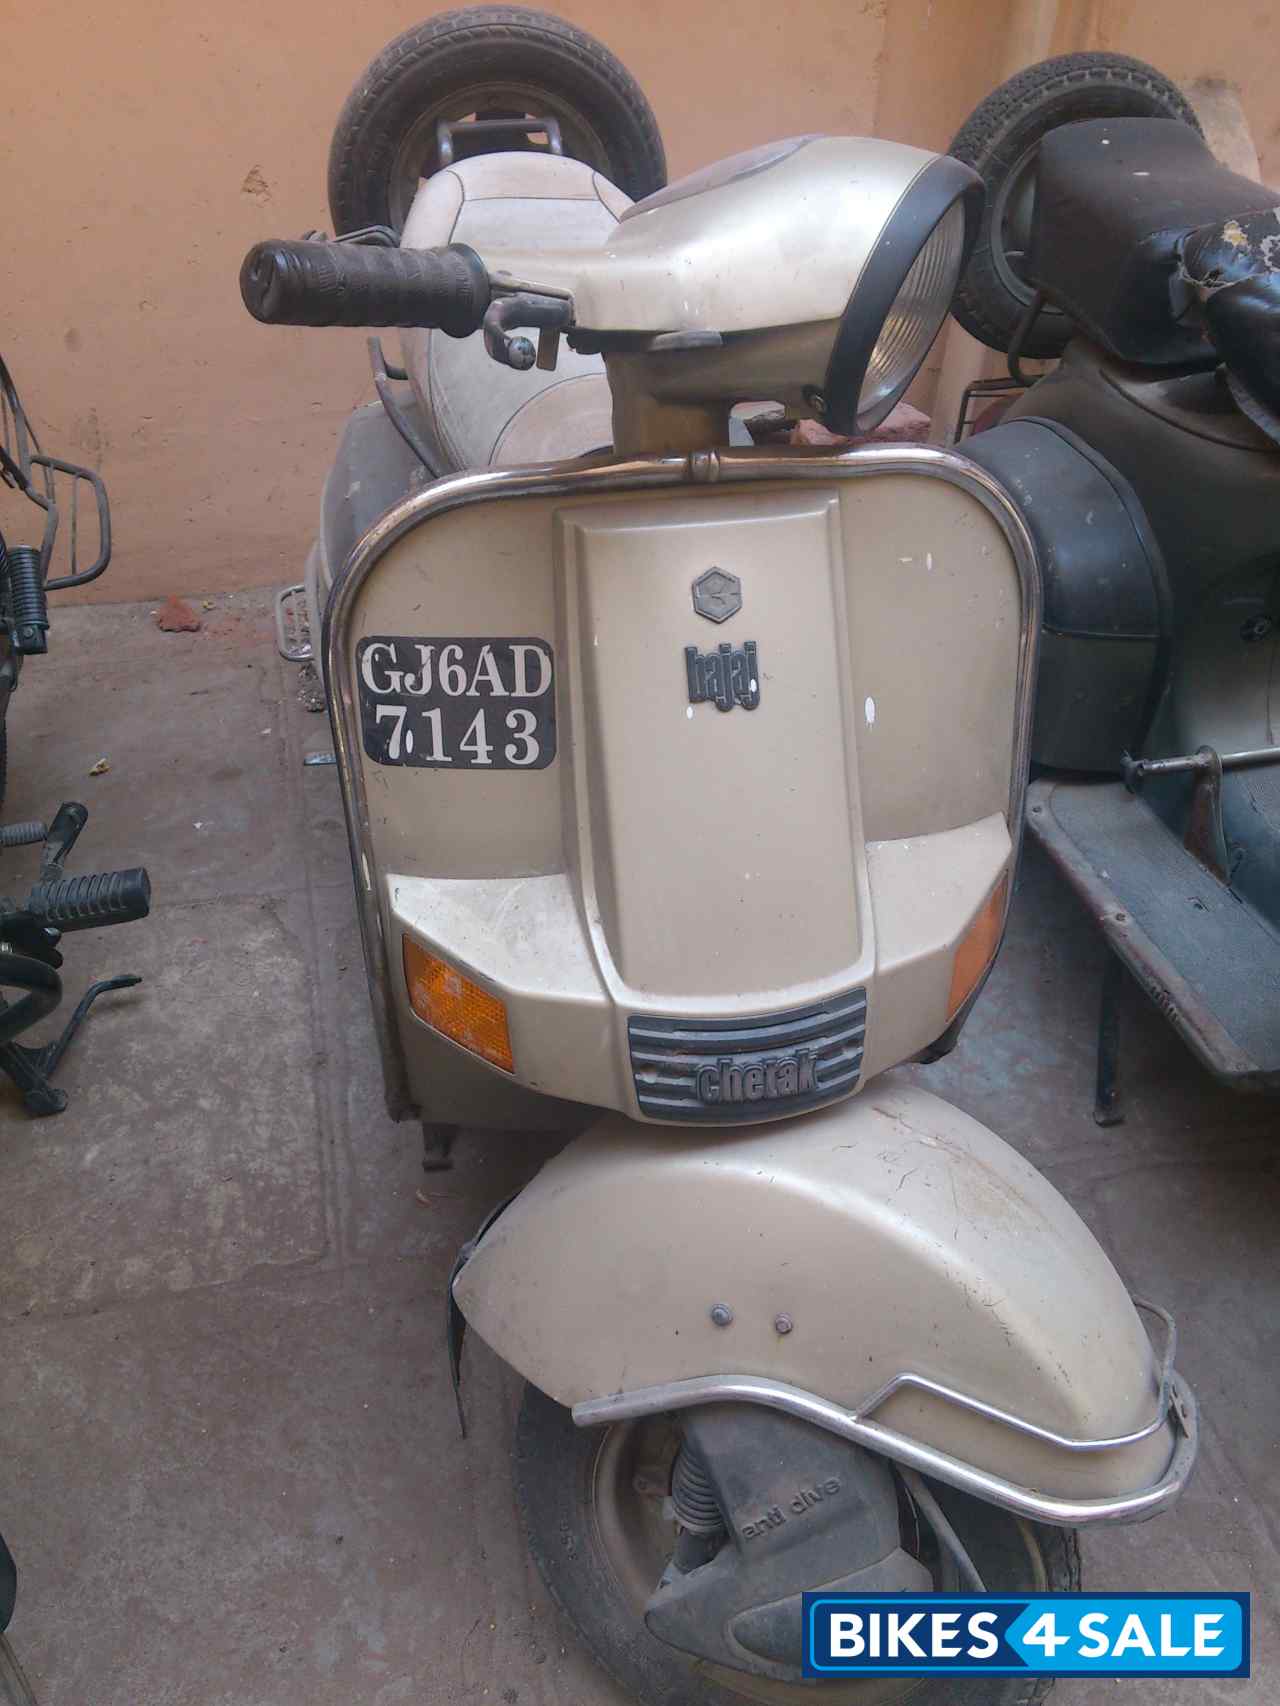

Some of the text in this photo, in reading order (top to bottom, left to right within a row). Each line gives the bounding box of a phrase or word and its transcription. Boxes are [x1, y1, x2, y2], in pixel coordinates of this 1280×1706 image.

[361, 642, 553, 698] GJ6AD
[685, 640, 760, 712] bajaj
[375, 703, 541, 766] 7143
[697, 1048, 818, 1103] chetak
[741, 1475, 841, 1541] anti dive
